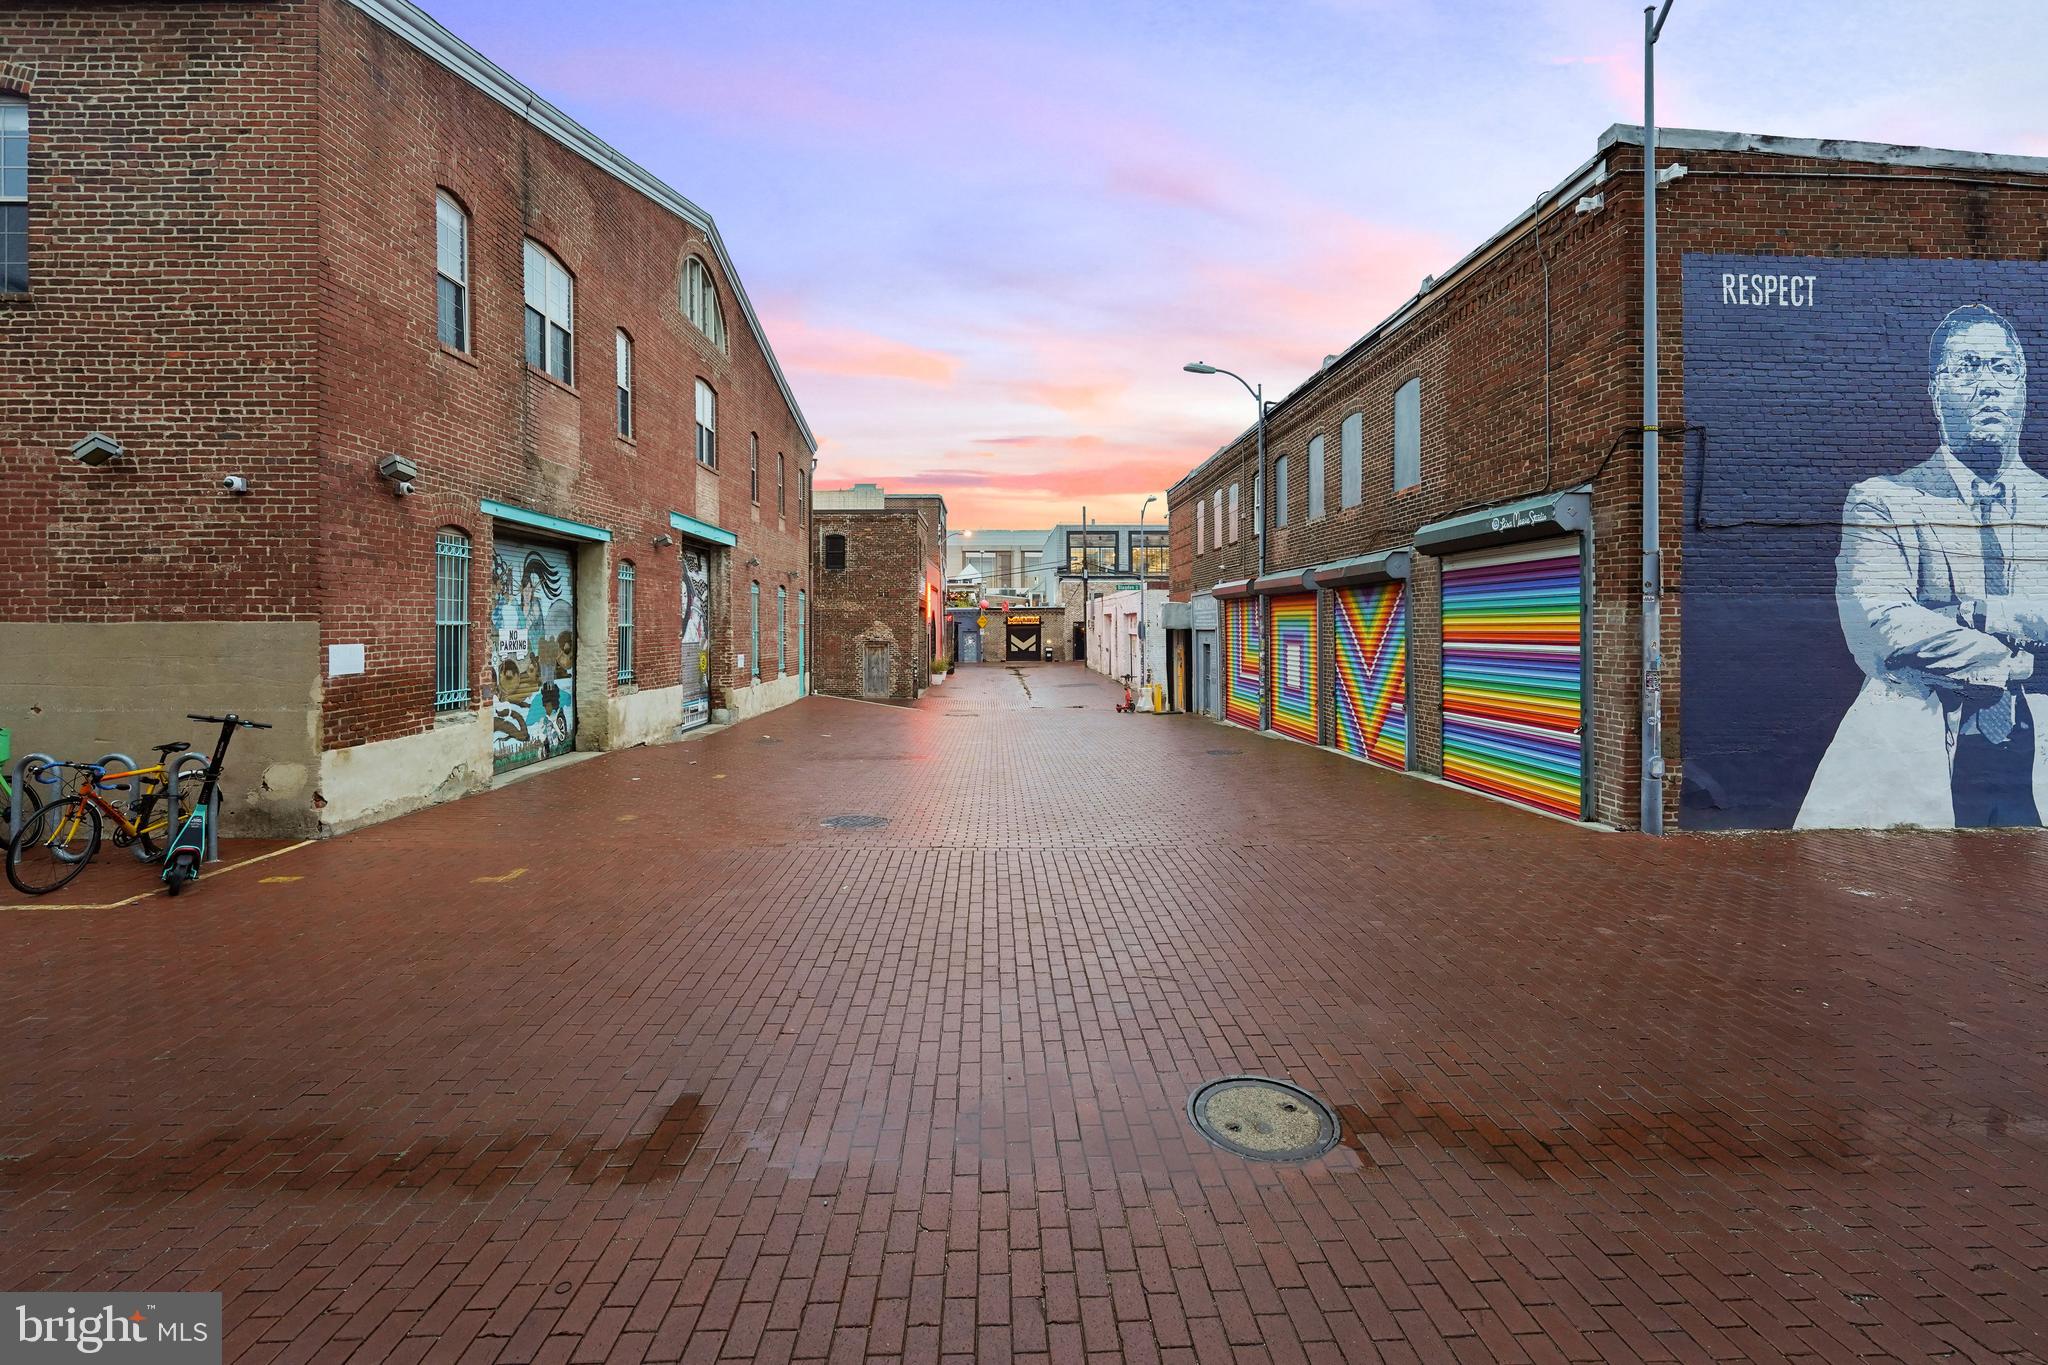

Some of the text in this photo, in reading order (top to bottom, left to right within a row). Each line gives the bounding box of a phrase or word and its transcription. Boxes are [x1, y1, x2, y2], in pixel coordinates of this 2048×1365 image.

[1722, 273, 1817, 307] RESPECT
[509, 630, 518, 640] NO
[499, 640, 527, 651] PARKING
